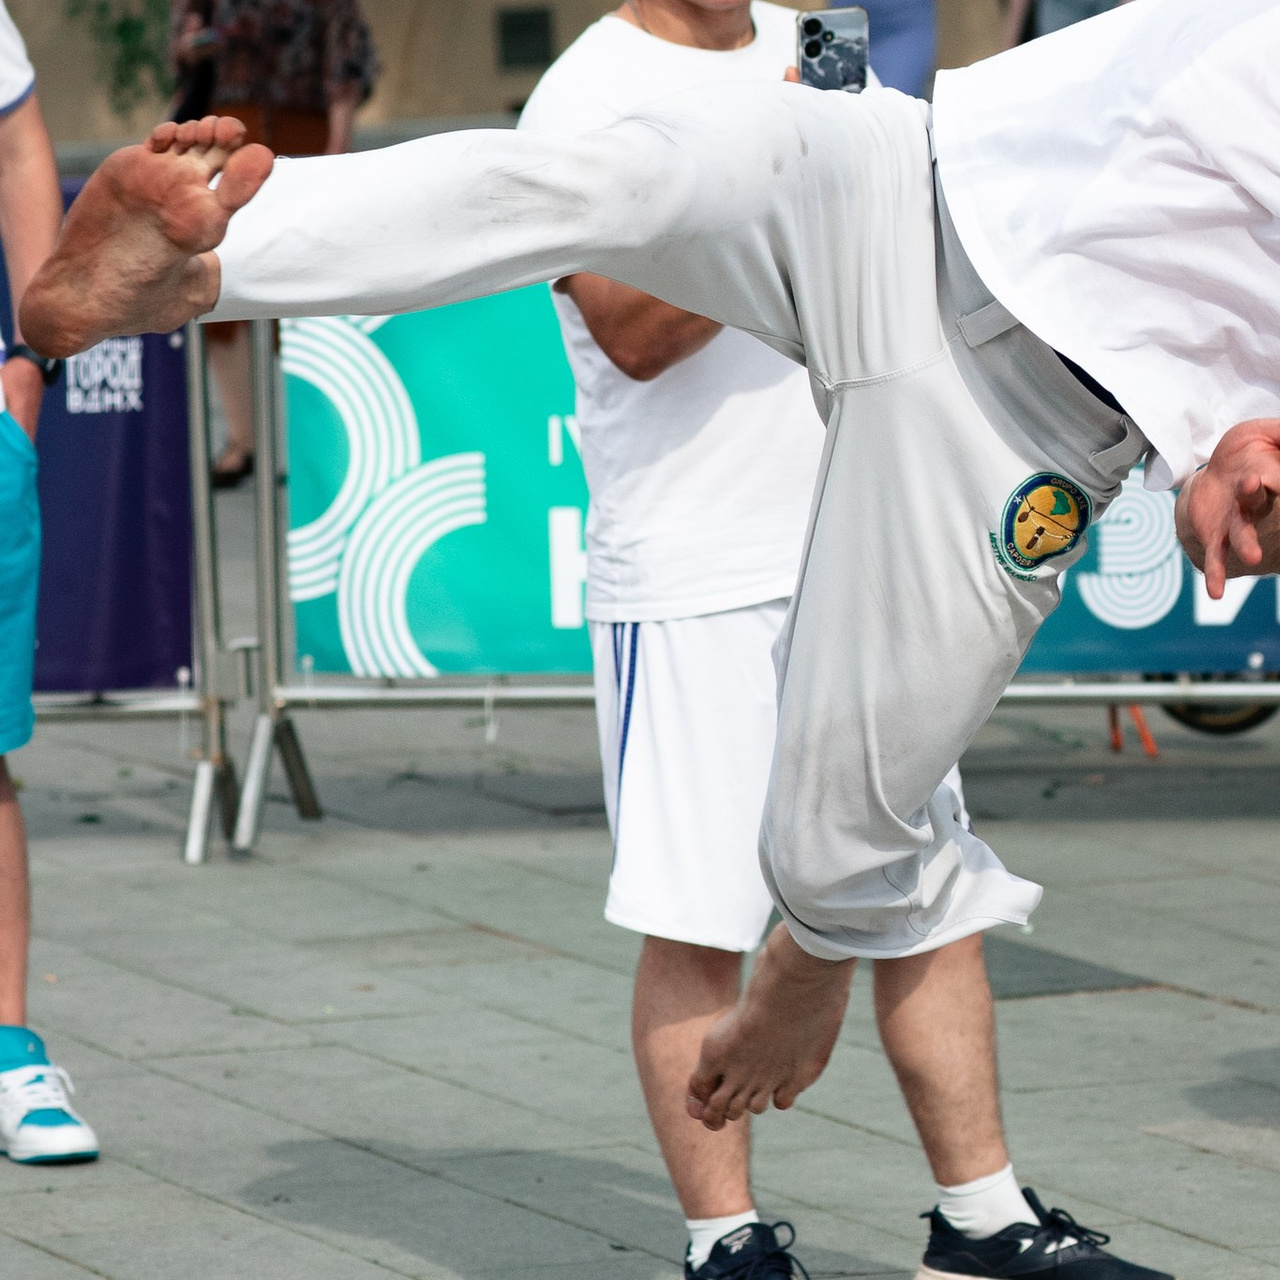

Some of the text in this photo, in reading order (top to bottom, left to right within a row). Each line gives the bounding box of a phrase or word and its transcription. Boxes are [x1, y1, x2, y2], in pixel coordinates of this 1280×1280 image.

[66, 352, 143, 389] ГОРОД
[66, 388, 144, 414] ВДНХ
[1050, 477, 1077, 495] GRUPO
